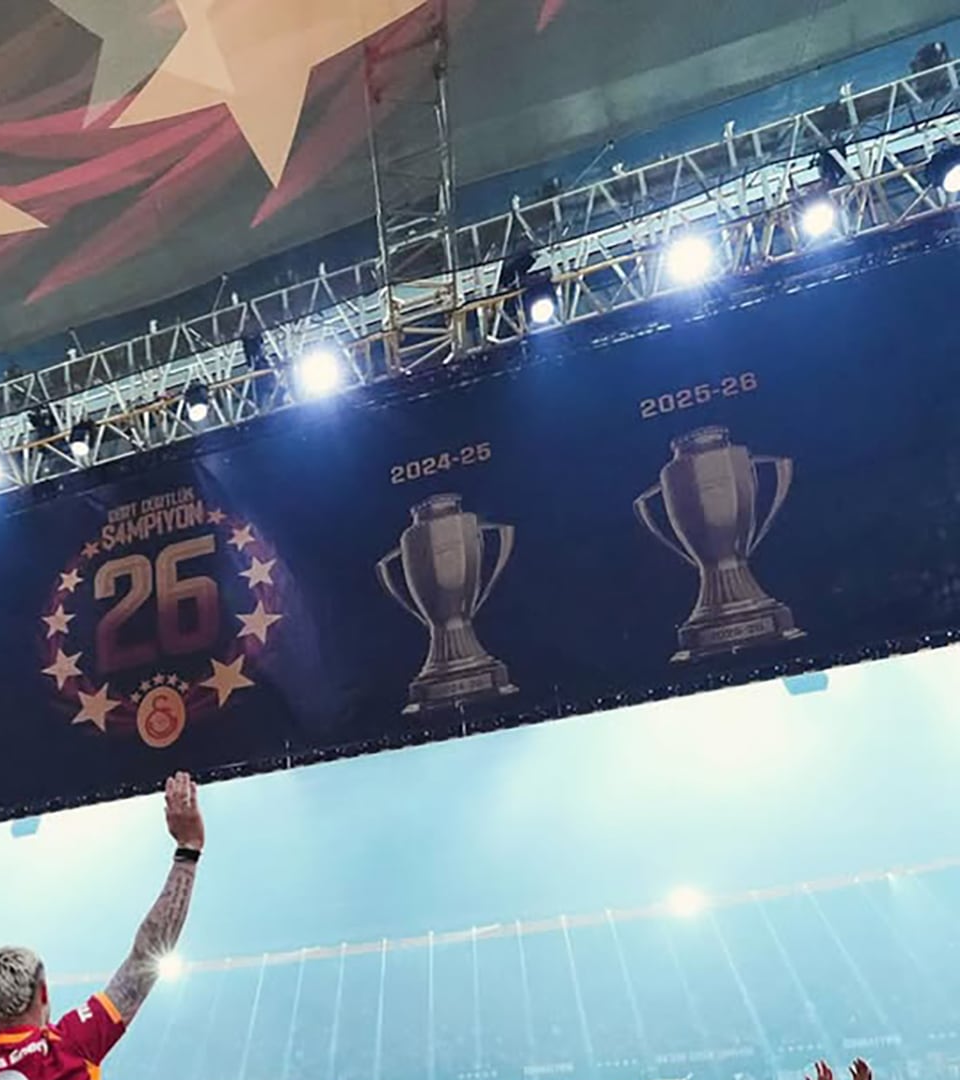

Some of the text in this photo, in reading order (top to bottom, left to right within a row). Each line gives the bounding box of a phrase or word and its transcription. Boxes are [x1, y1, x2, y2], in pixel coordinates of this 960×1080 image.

[640, 371, 759, 419] 2025-26
[390, 441, 492, 485] 2024-25
[93, 533, 220, 674] 26
